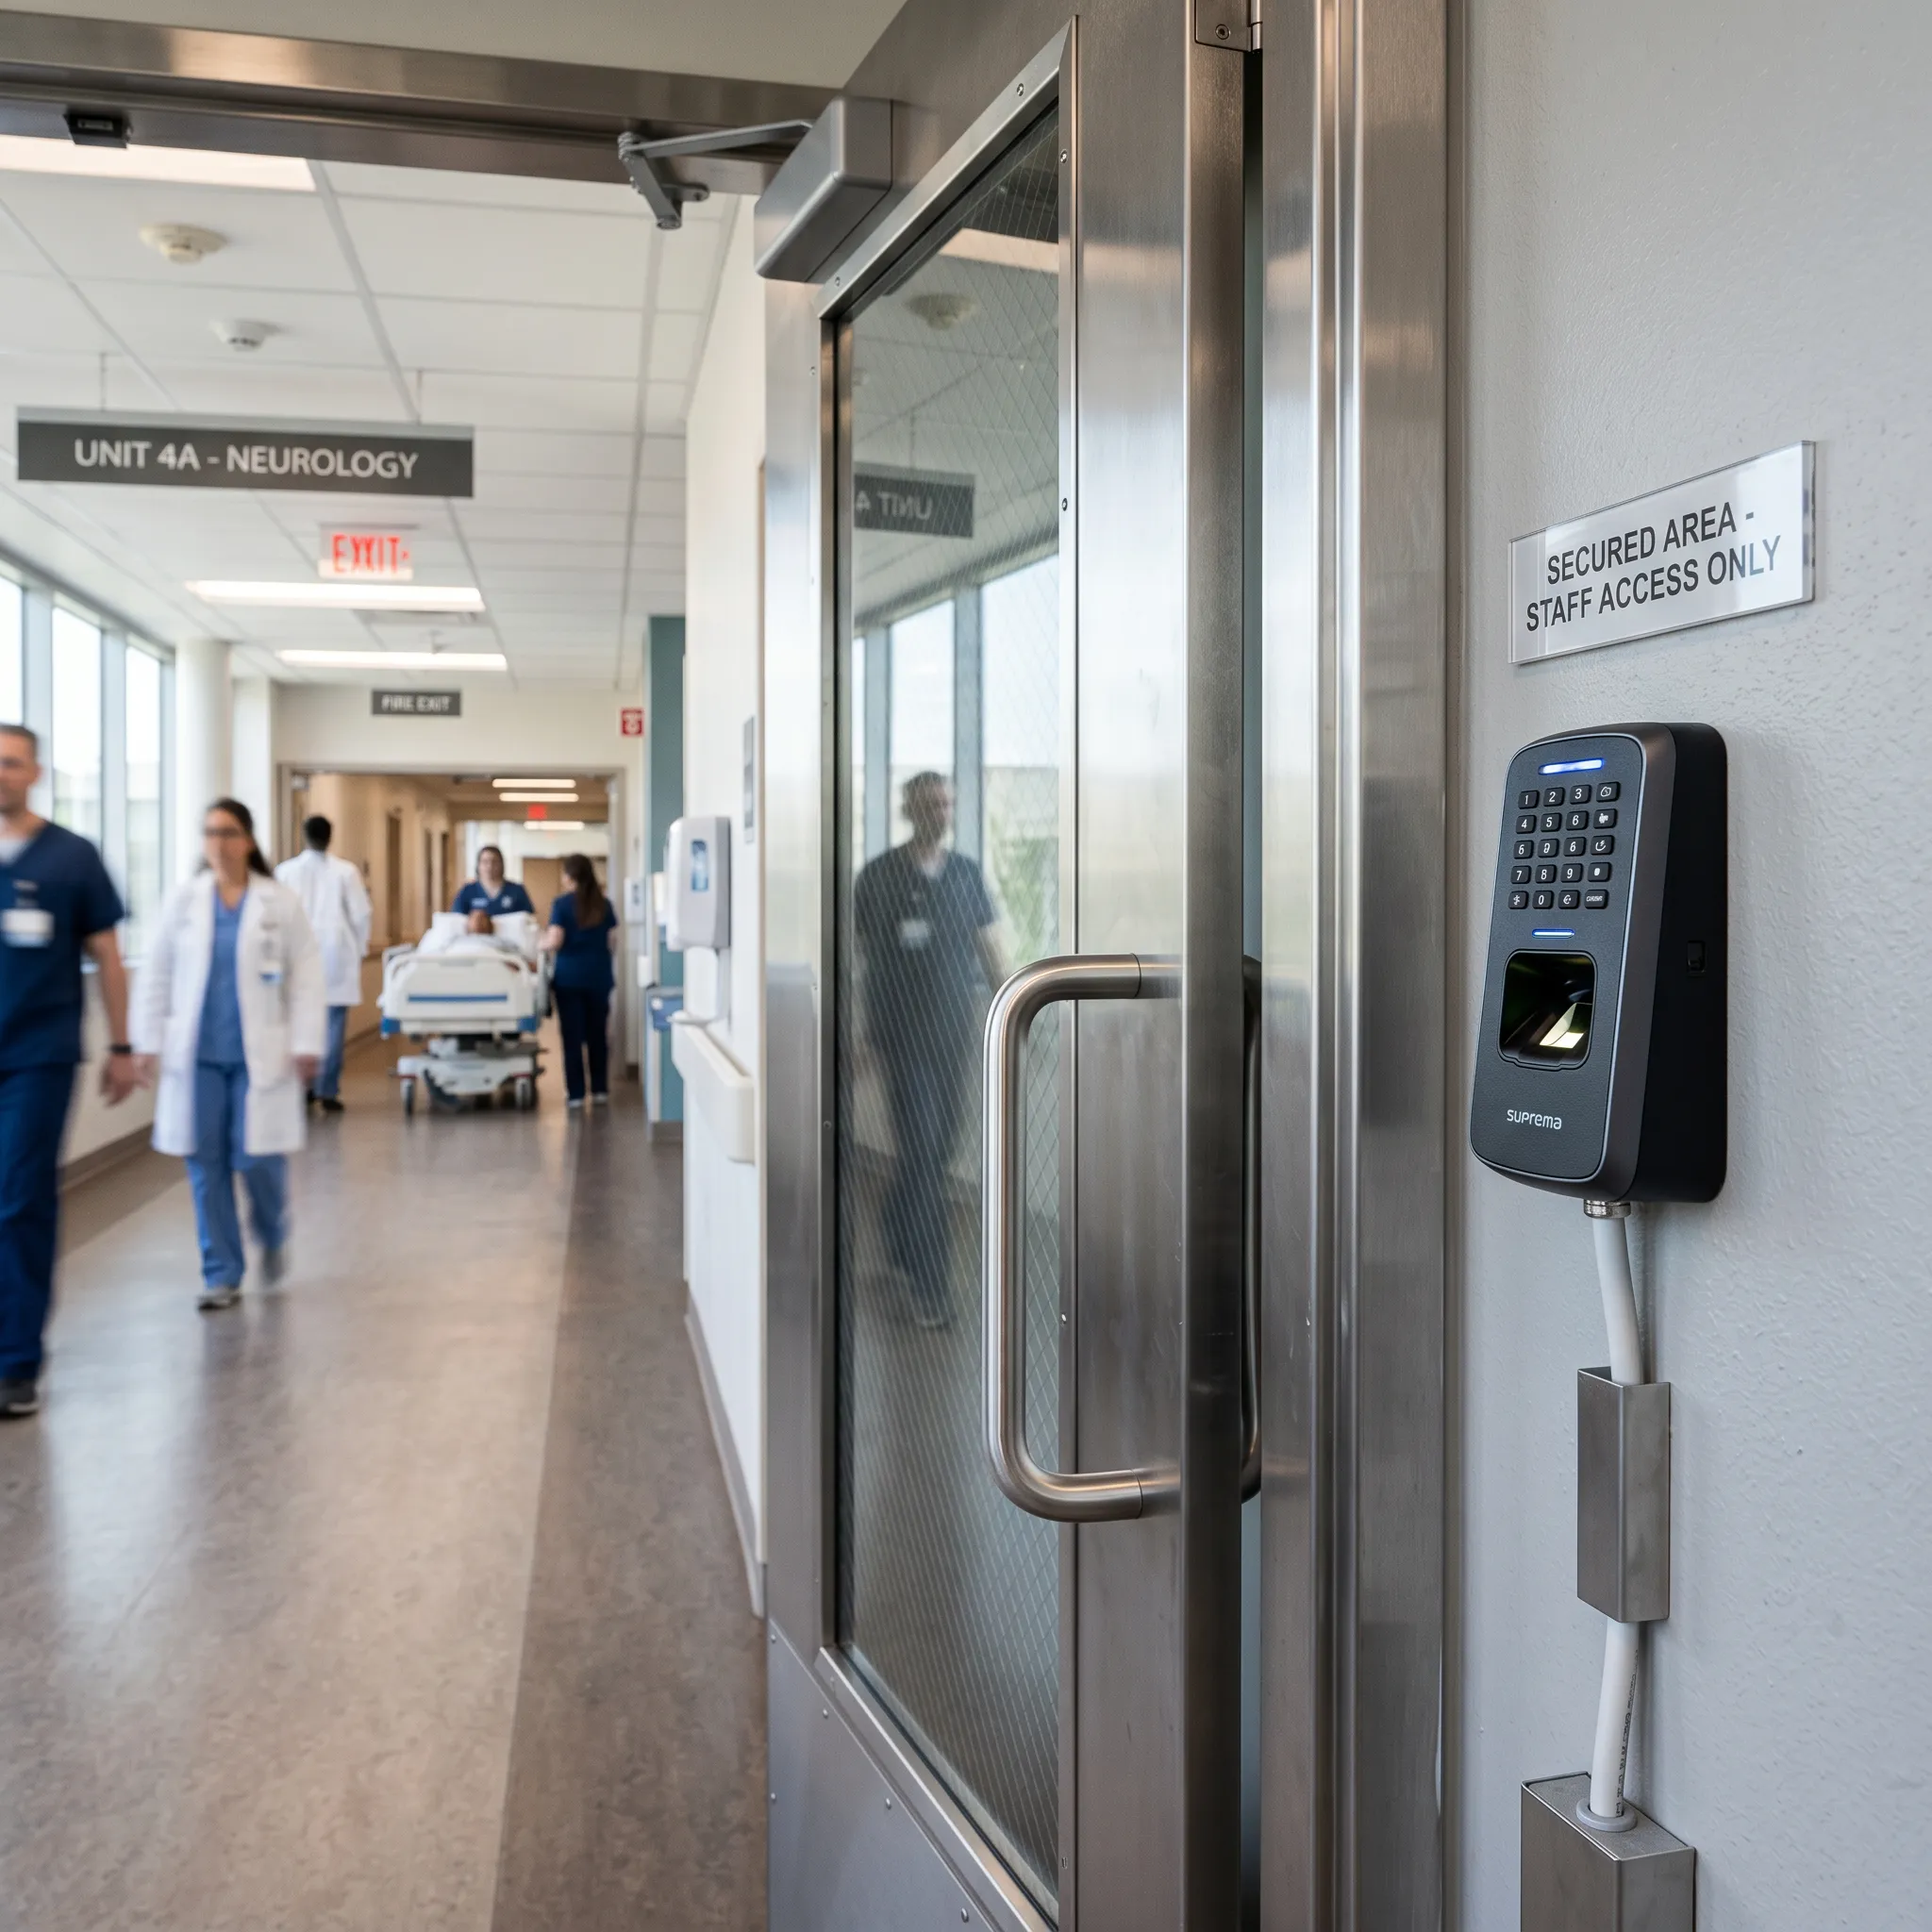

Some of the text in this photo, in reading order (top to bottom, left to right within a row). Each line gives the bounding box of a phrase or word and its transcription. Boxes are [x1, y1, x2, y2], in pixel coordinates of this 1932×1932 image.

[74, 439, 151, 470] UNIT
[157, 442, 201, 471] 4A
[226, 445, 419, 479] NEUROLOGY
[1547, 502, 1755, 585] SECURED AREA -
[1526, 535, 1781, 632] STAFF ACCESS ONLY
[1524, 788, 1582, 805] 1 2 3
[1521, 815, 1579, 829] 4 5 6
[1519, 844, 1525, 855] 6
[1516, 868, 1574, 881] 7 8 9
[1538, 895, 1544, 906] 0
[1507, 1108, 1562, 1130] suprema
